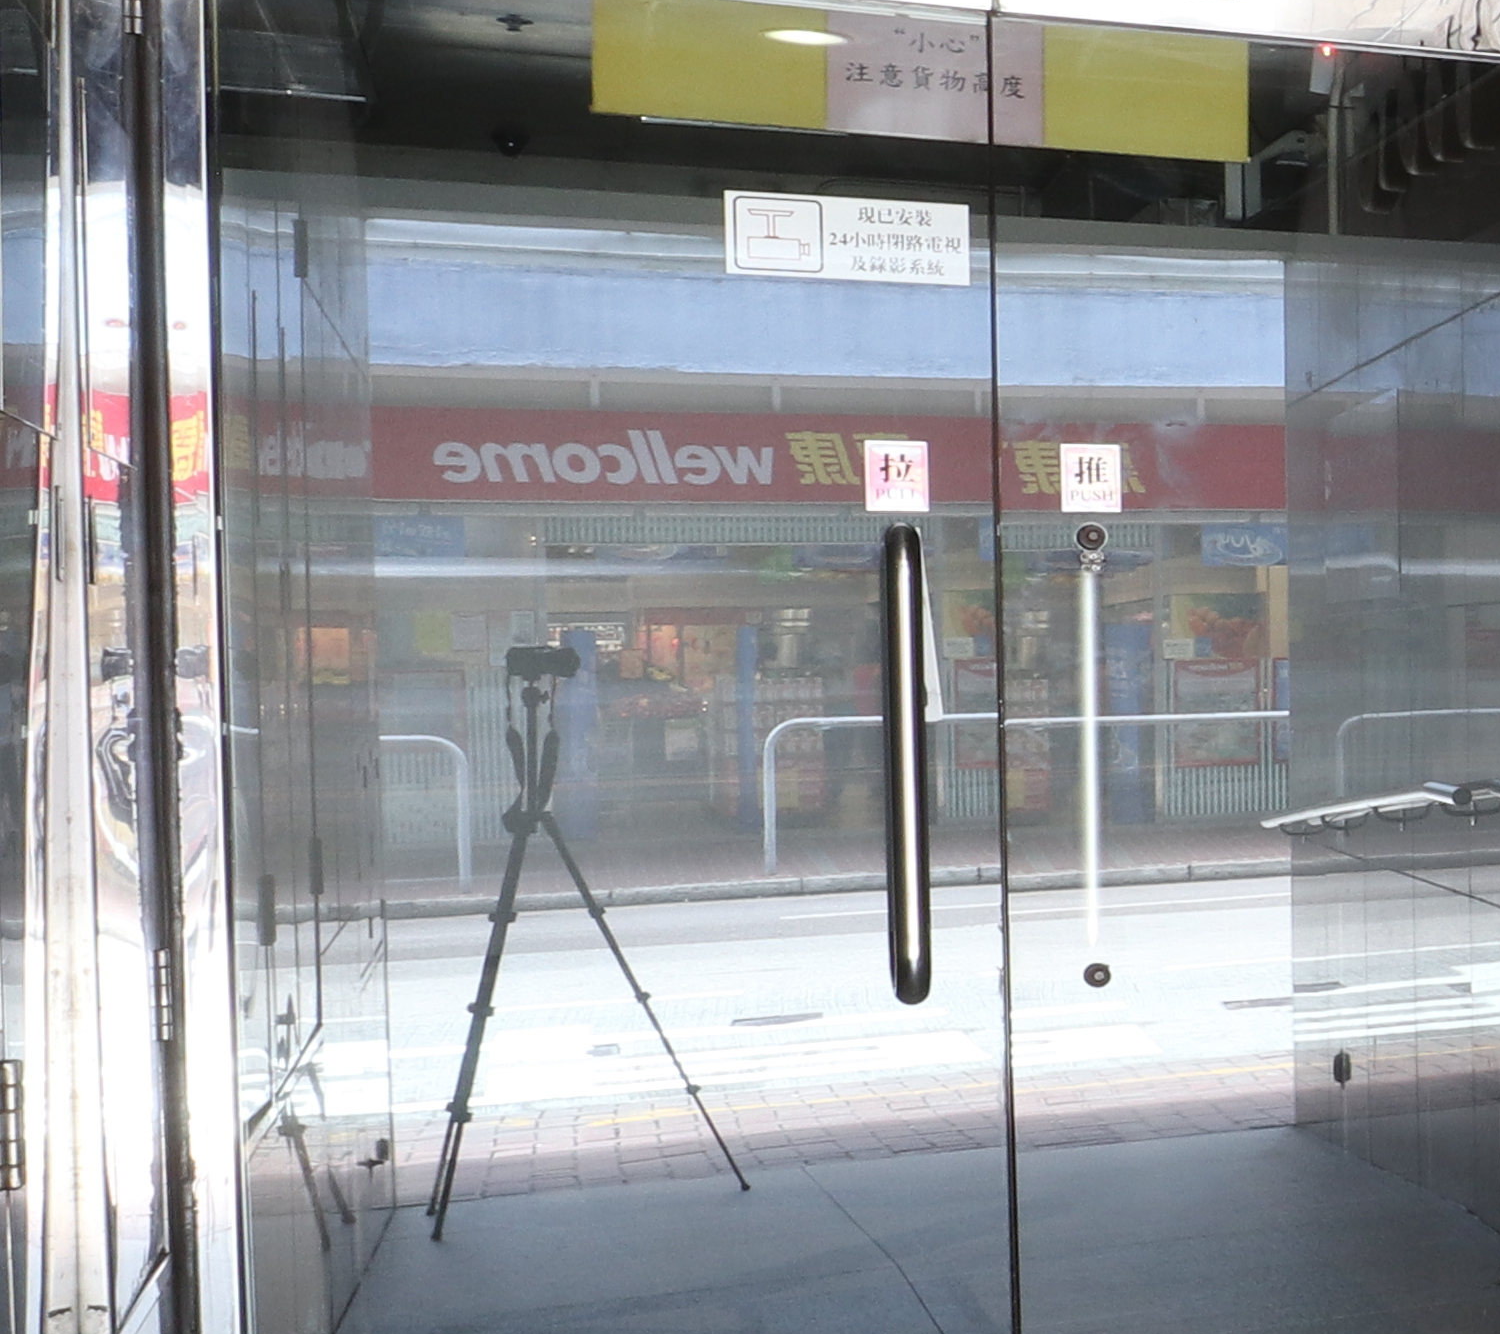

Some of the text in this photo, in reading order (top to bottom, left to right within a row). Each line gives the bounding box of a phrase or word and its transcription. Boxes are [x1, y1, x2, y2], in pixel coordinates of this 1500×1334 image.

[845, 61, 1026, 100] 注意貨物高度
[857, 205, 933, 228] 現已安裝
[828, 231, 963, 255] 24小時閉路電視
[879, 453, 915, 483] 拉
[1073, 456, 1109, 485] 推
[875, 487, 922, 501] PULL
[1070, 489, 1115, 503] PUSH
